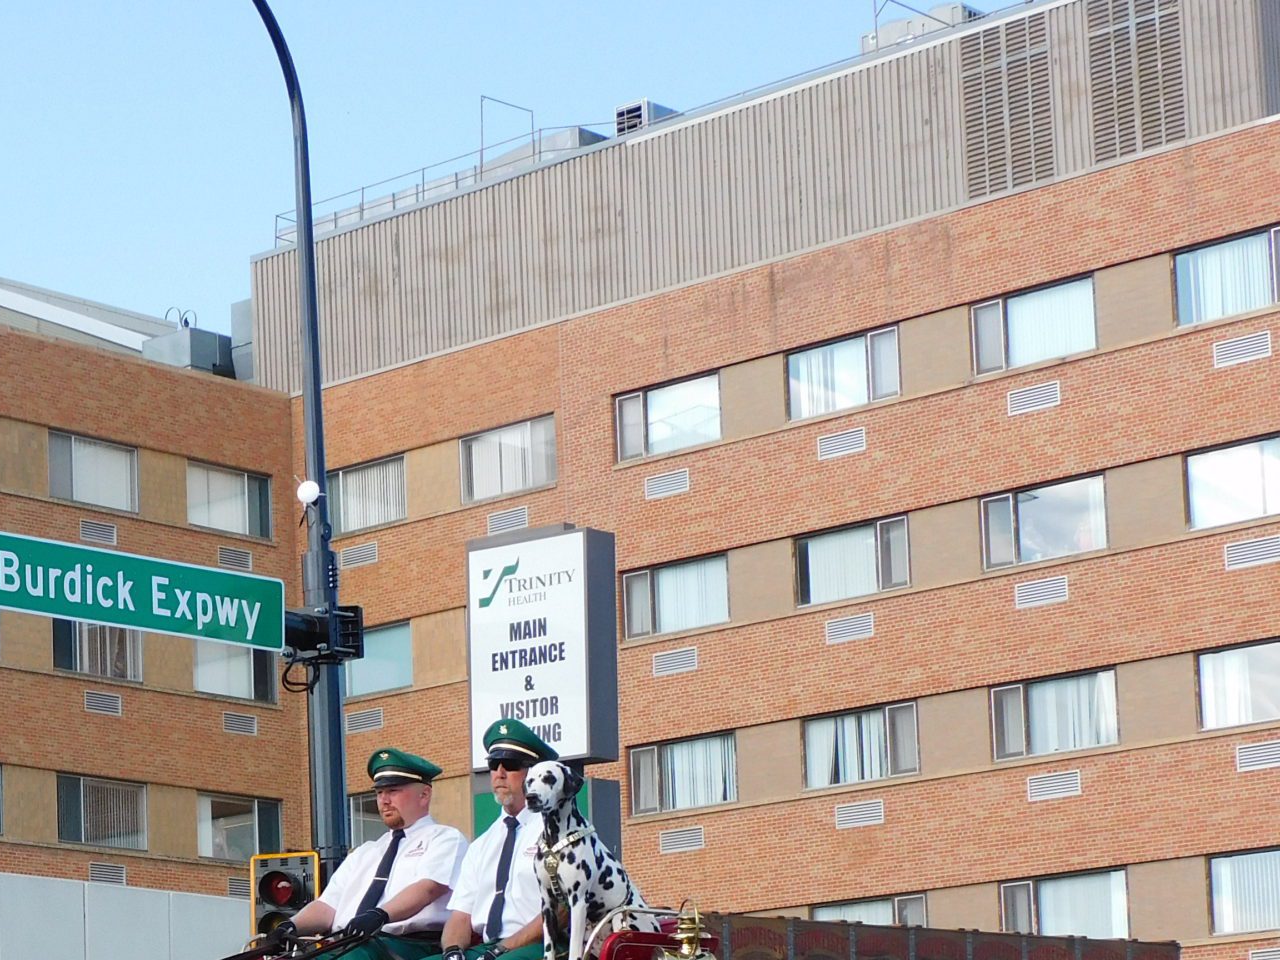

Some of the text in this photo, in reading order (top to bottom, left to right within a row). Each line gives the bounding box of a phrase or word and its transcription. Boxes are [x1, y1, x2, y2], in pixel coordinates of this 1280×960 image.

[504, 568, 576, 594] TRINITY
[151, 575, 261, 640] Expwy
[507, 591, 547, 607] HEALTH
[509, 617, 547, 642] MAIN
[491, 641, 566, 673] ENTRANCE
[524, 674, 535, 692] &
[499, 696, 559, 721] VISITOR
